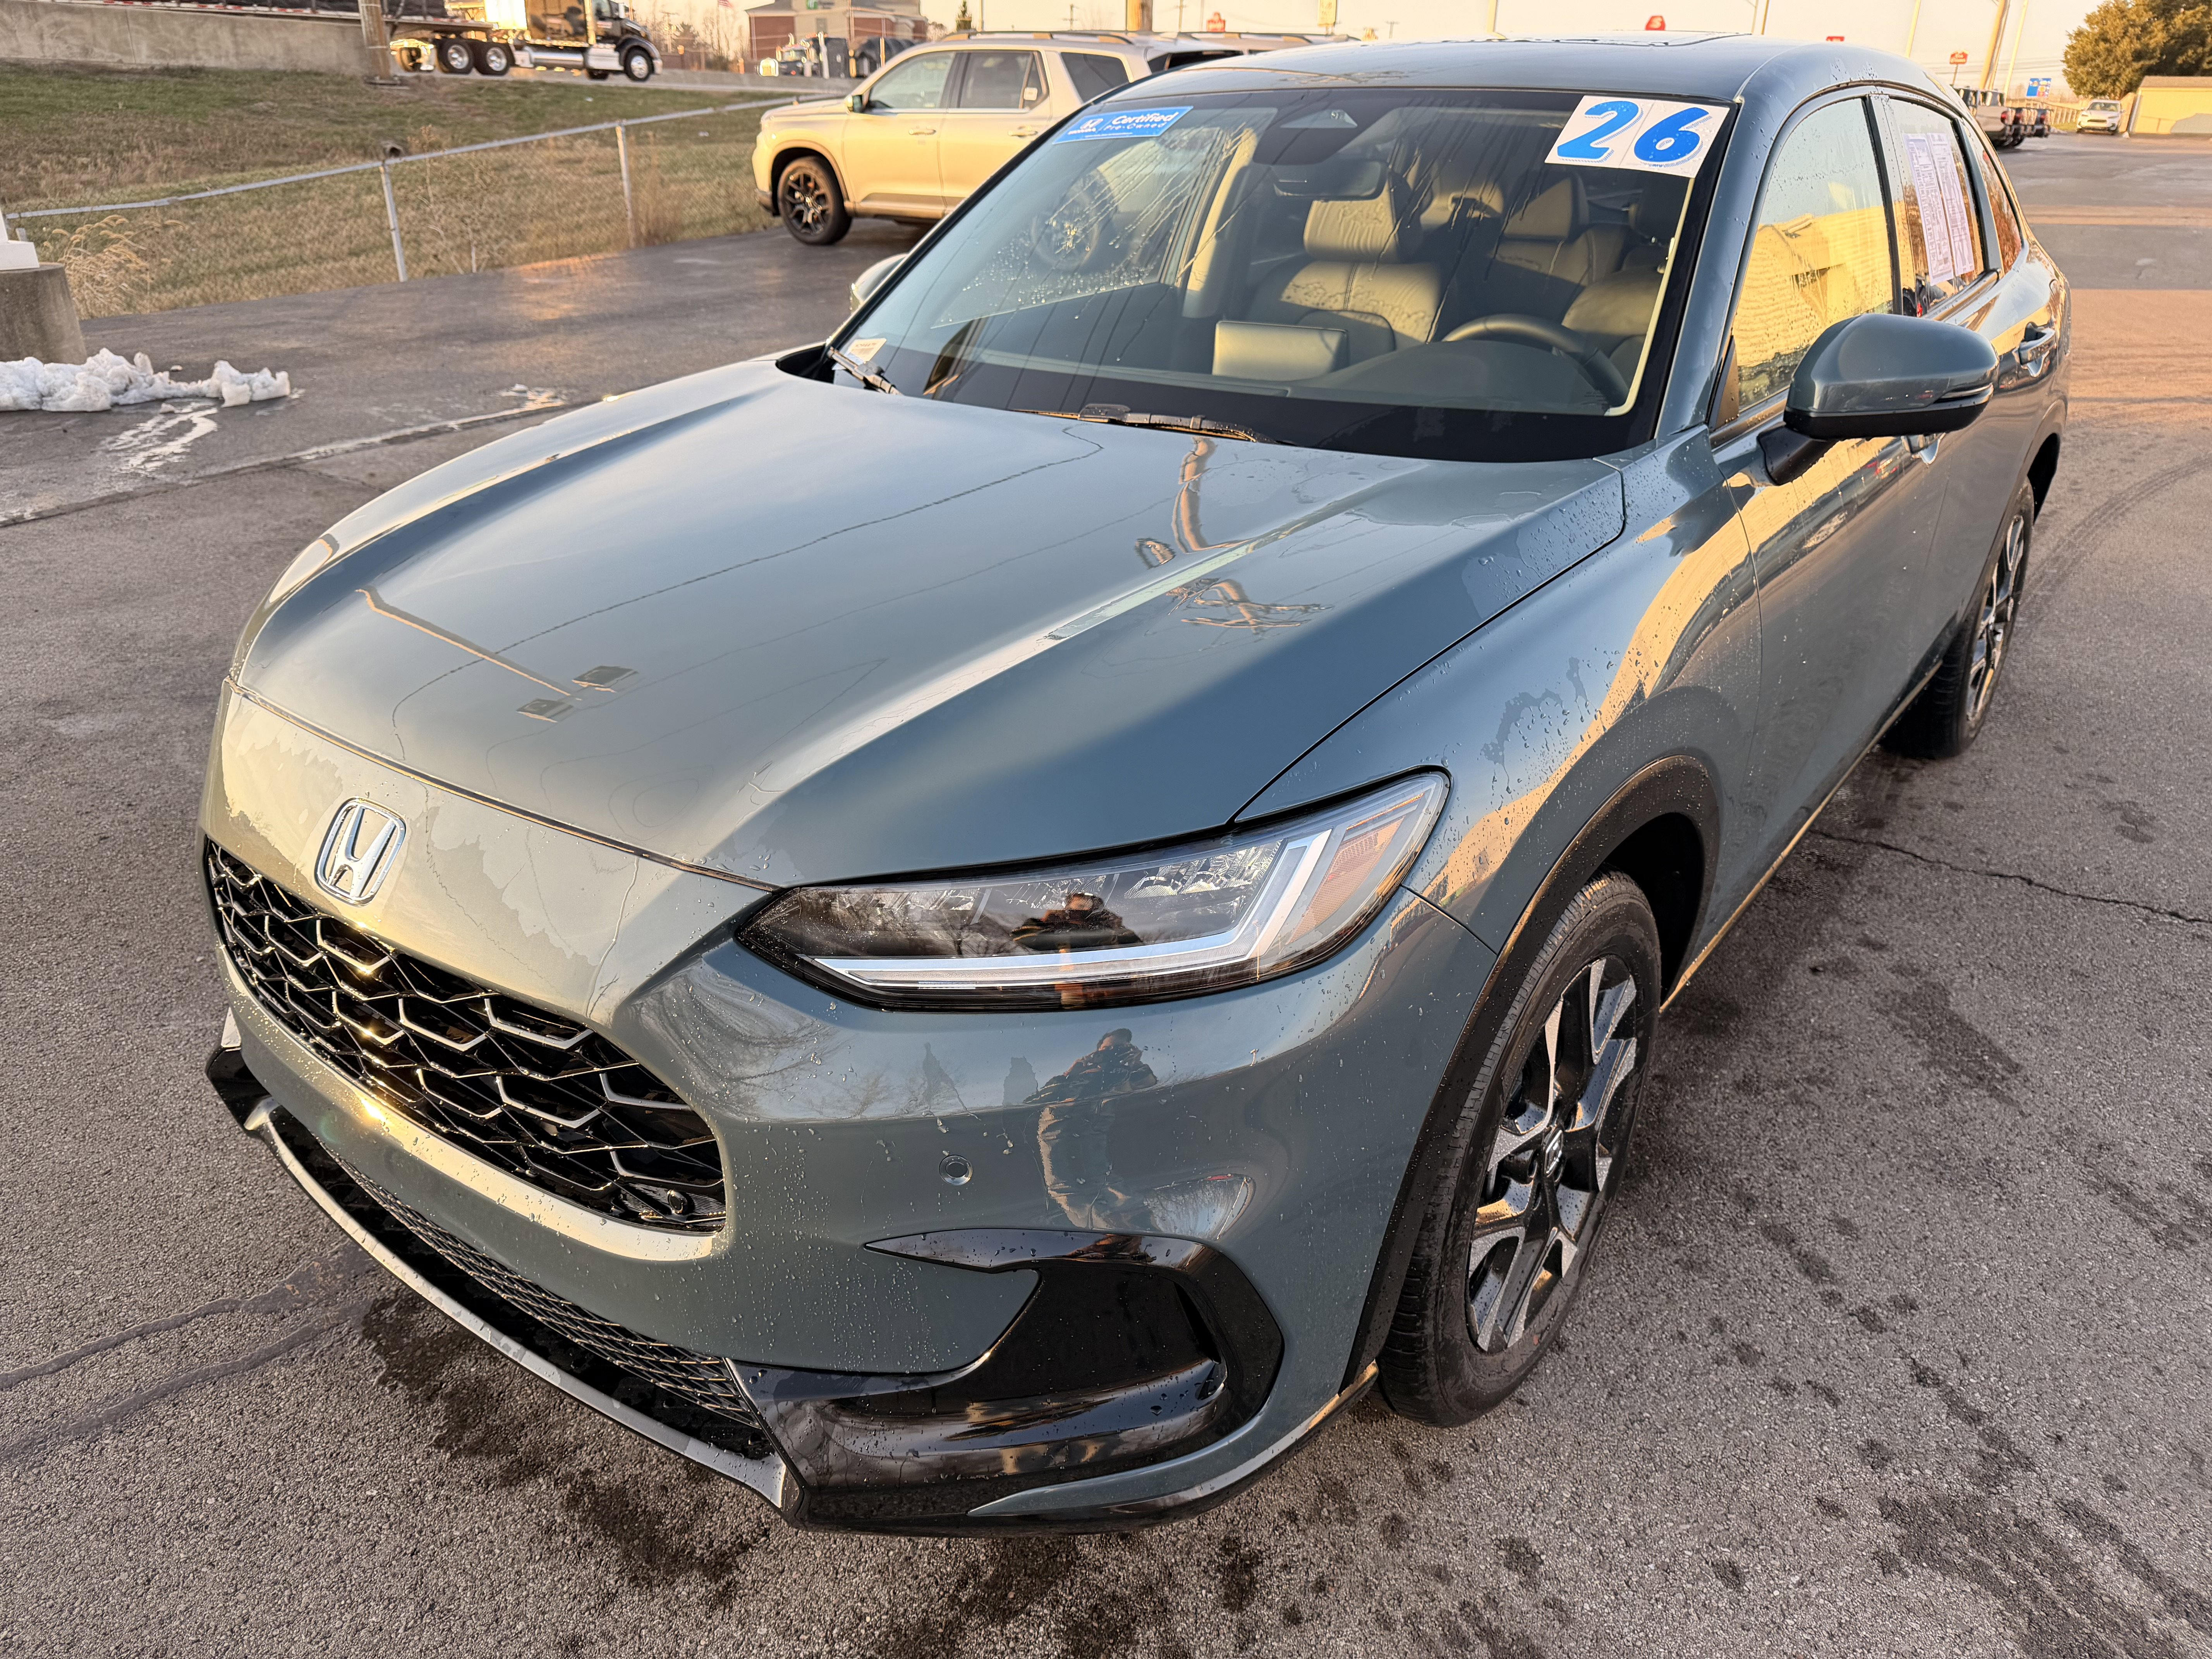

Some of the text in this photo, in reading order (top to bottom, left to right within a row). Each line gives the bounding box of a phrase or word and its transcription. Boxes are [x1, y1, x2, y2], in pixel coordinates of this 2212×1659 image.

[1112, 112, 1179, 125] Certified
[1104, 122, 1167, 131] Pre-Owned
[1557, 101, 1712, 167] 26
